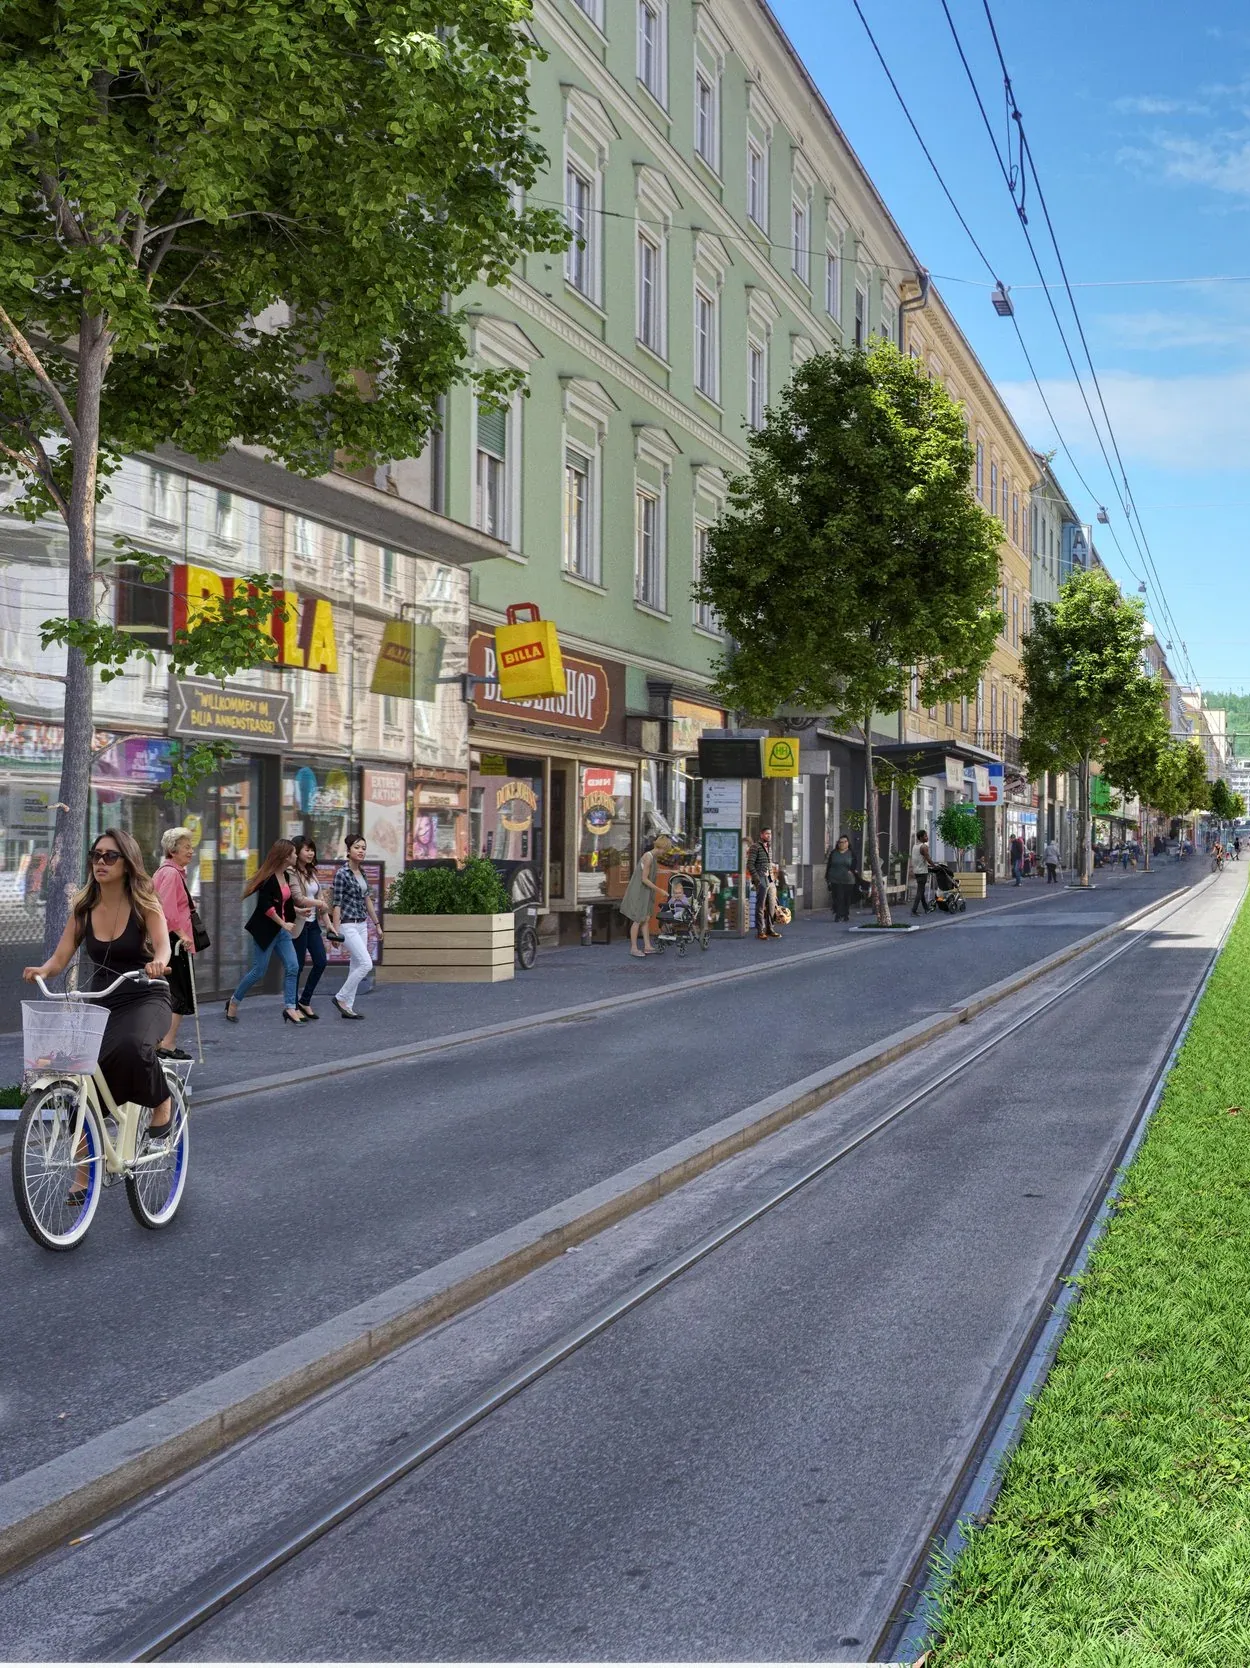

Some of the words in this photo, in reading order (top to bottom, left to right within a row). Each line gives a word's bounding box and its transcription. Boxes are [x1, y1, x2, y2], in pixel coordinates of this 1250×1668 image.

[505, 646, 541, 664] BILLA
[200, 692, 257, 713] WILLKOMMEN
[258, 701, 269, 716] IM
[191, 709, 213, 727] BILLA
[371, 776, 400, 789] EXTREM
[371, 788, 401, 801] AKTION
